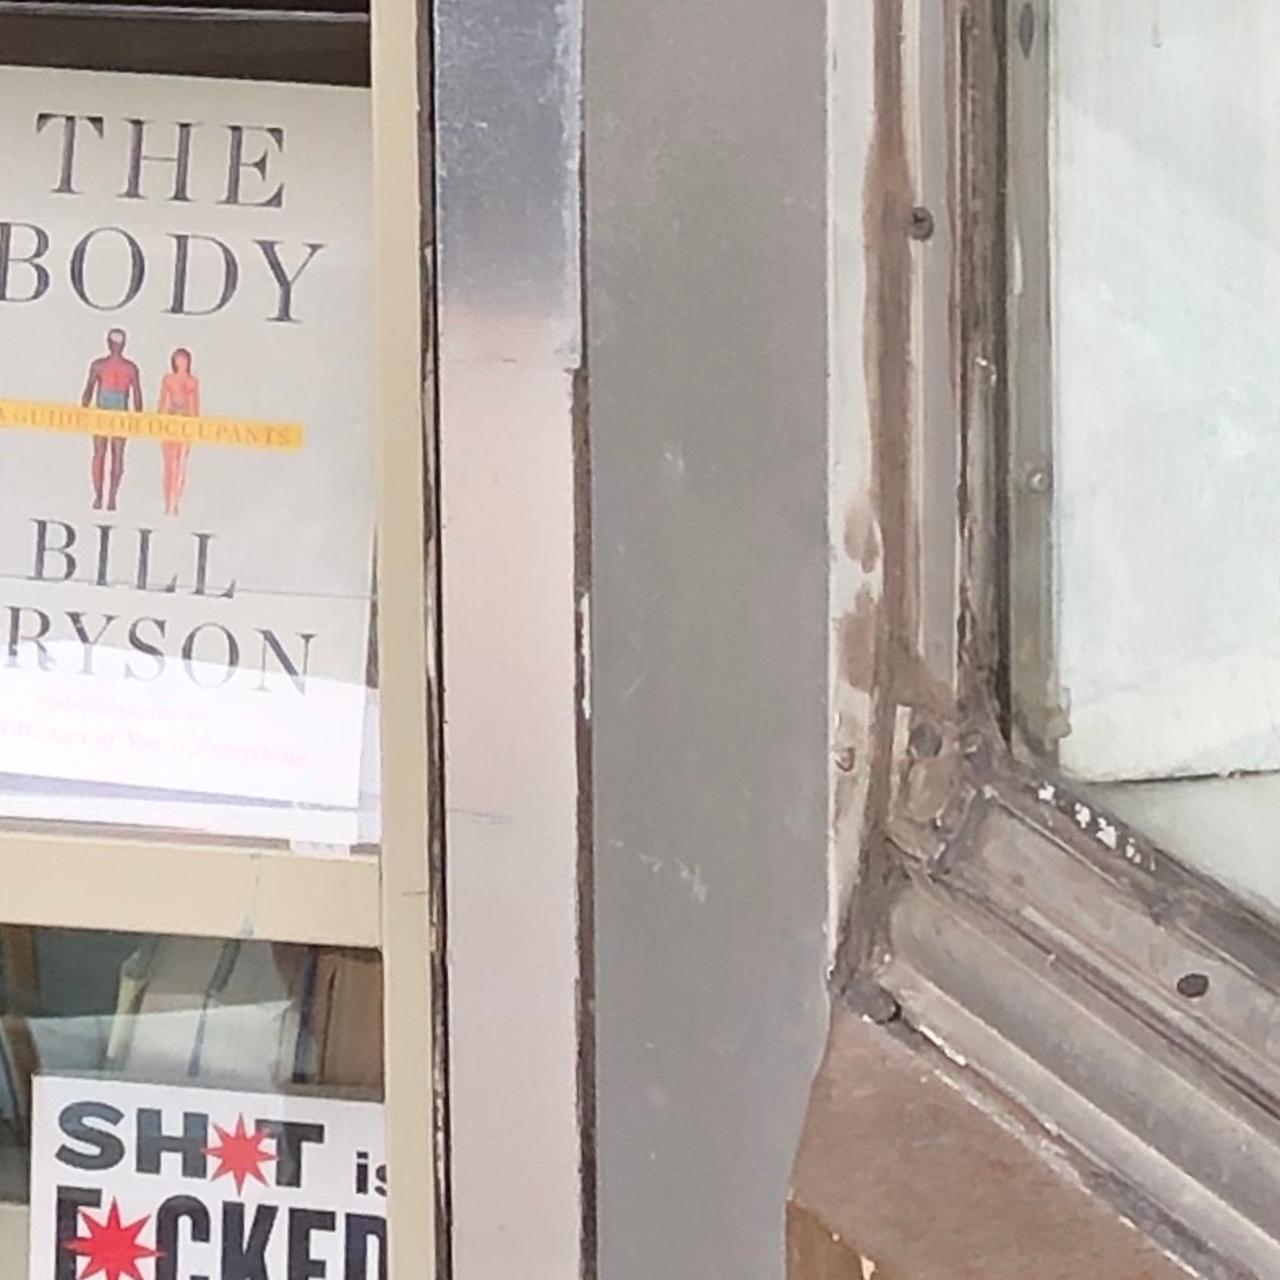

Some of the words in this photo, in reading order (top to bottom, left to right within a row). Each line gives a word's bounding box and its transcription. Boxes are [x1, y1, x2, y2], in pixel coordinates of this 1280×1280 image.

[36, 112, 287, 210] THE
[12, 408, 83, 428] GUIDE
[94, 413, 144, 433] FOR
[147, 417, 291, 445] OCCUPANTS
[27, 517, 238, 601] BILL
[55, 1100, 325, 1196] SHT
[55, 1186, 388, 1280] FCKED
